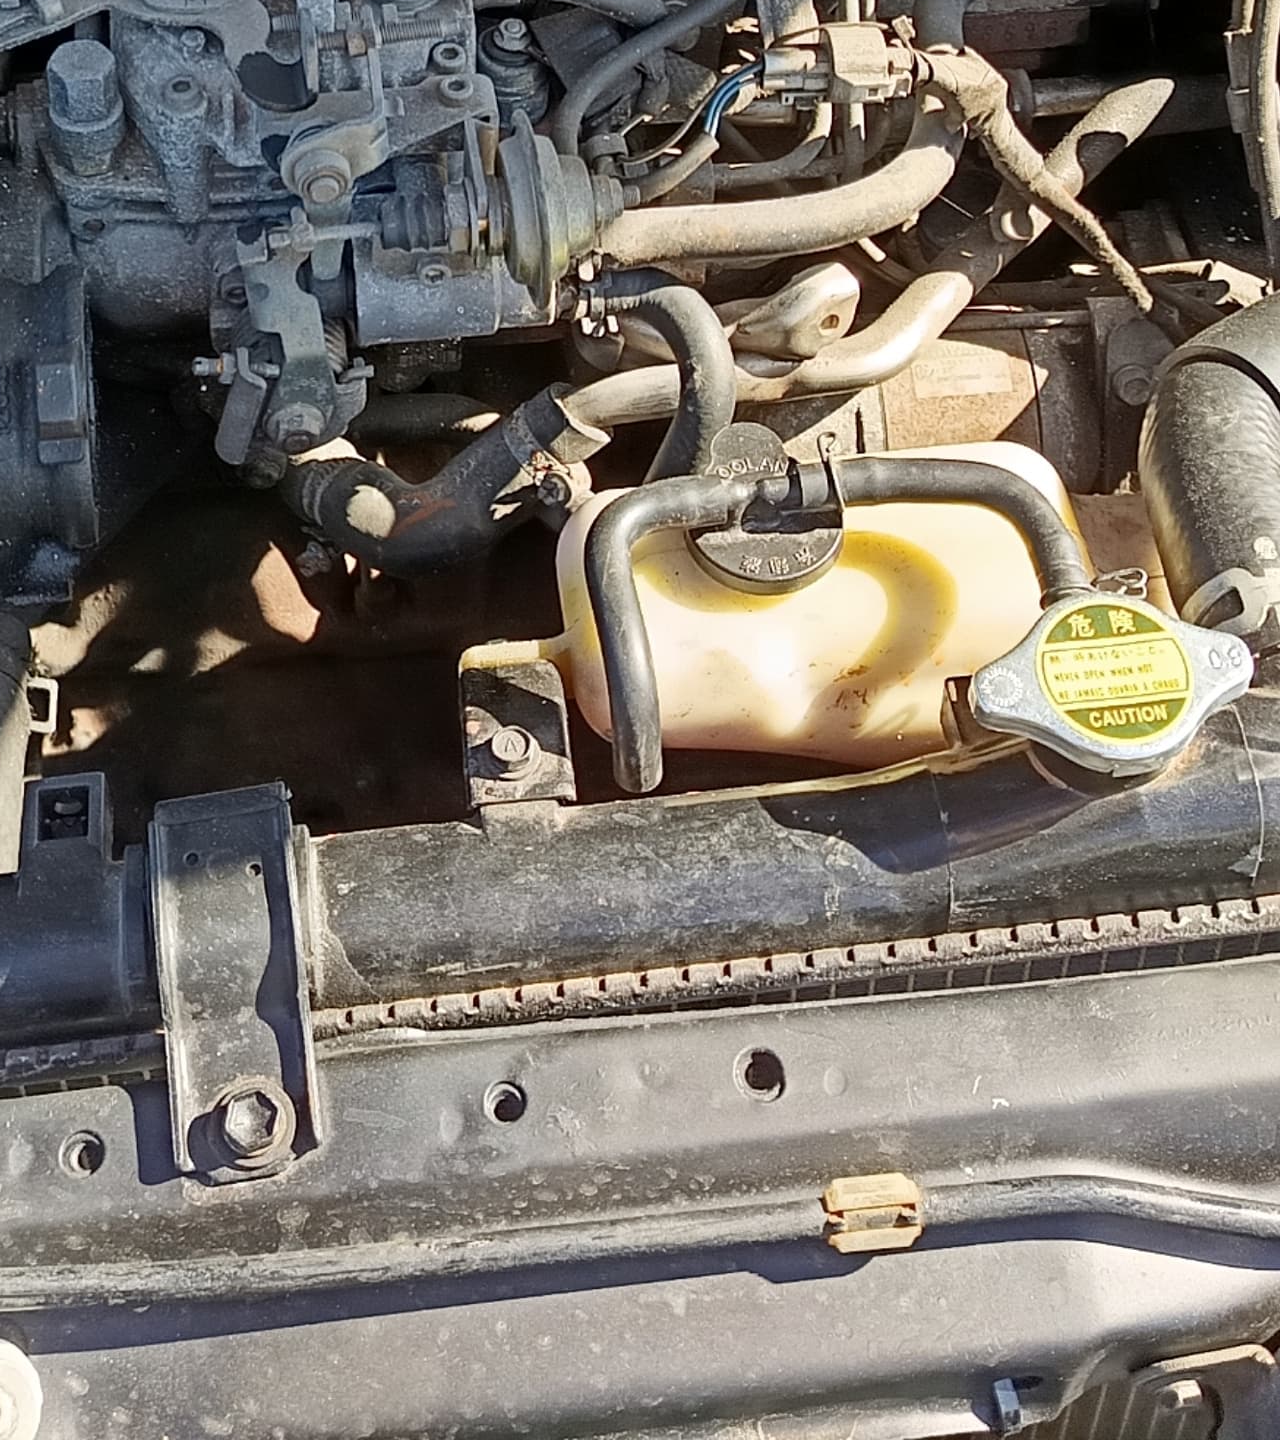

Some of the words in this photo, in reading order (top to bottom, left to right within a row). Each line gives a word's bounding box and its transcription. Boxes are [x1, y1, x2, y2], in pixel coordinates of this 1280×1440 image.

[716, 456, 789, 481] OOLAN
[1053, 671, 1080, 682] NEVER
[1083, 669, 1105, 680] OPEN
[1109, 665, 1134, 677] WHEN
[1088, 703, 1169, 729] CAUTION
